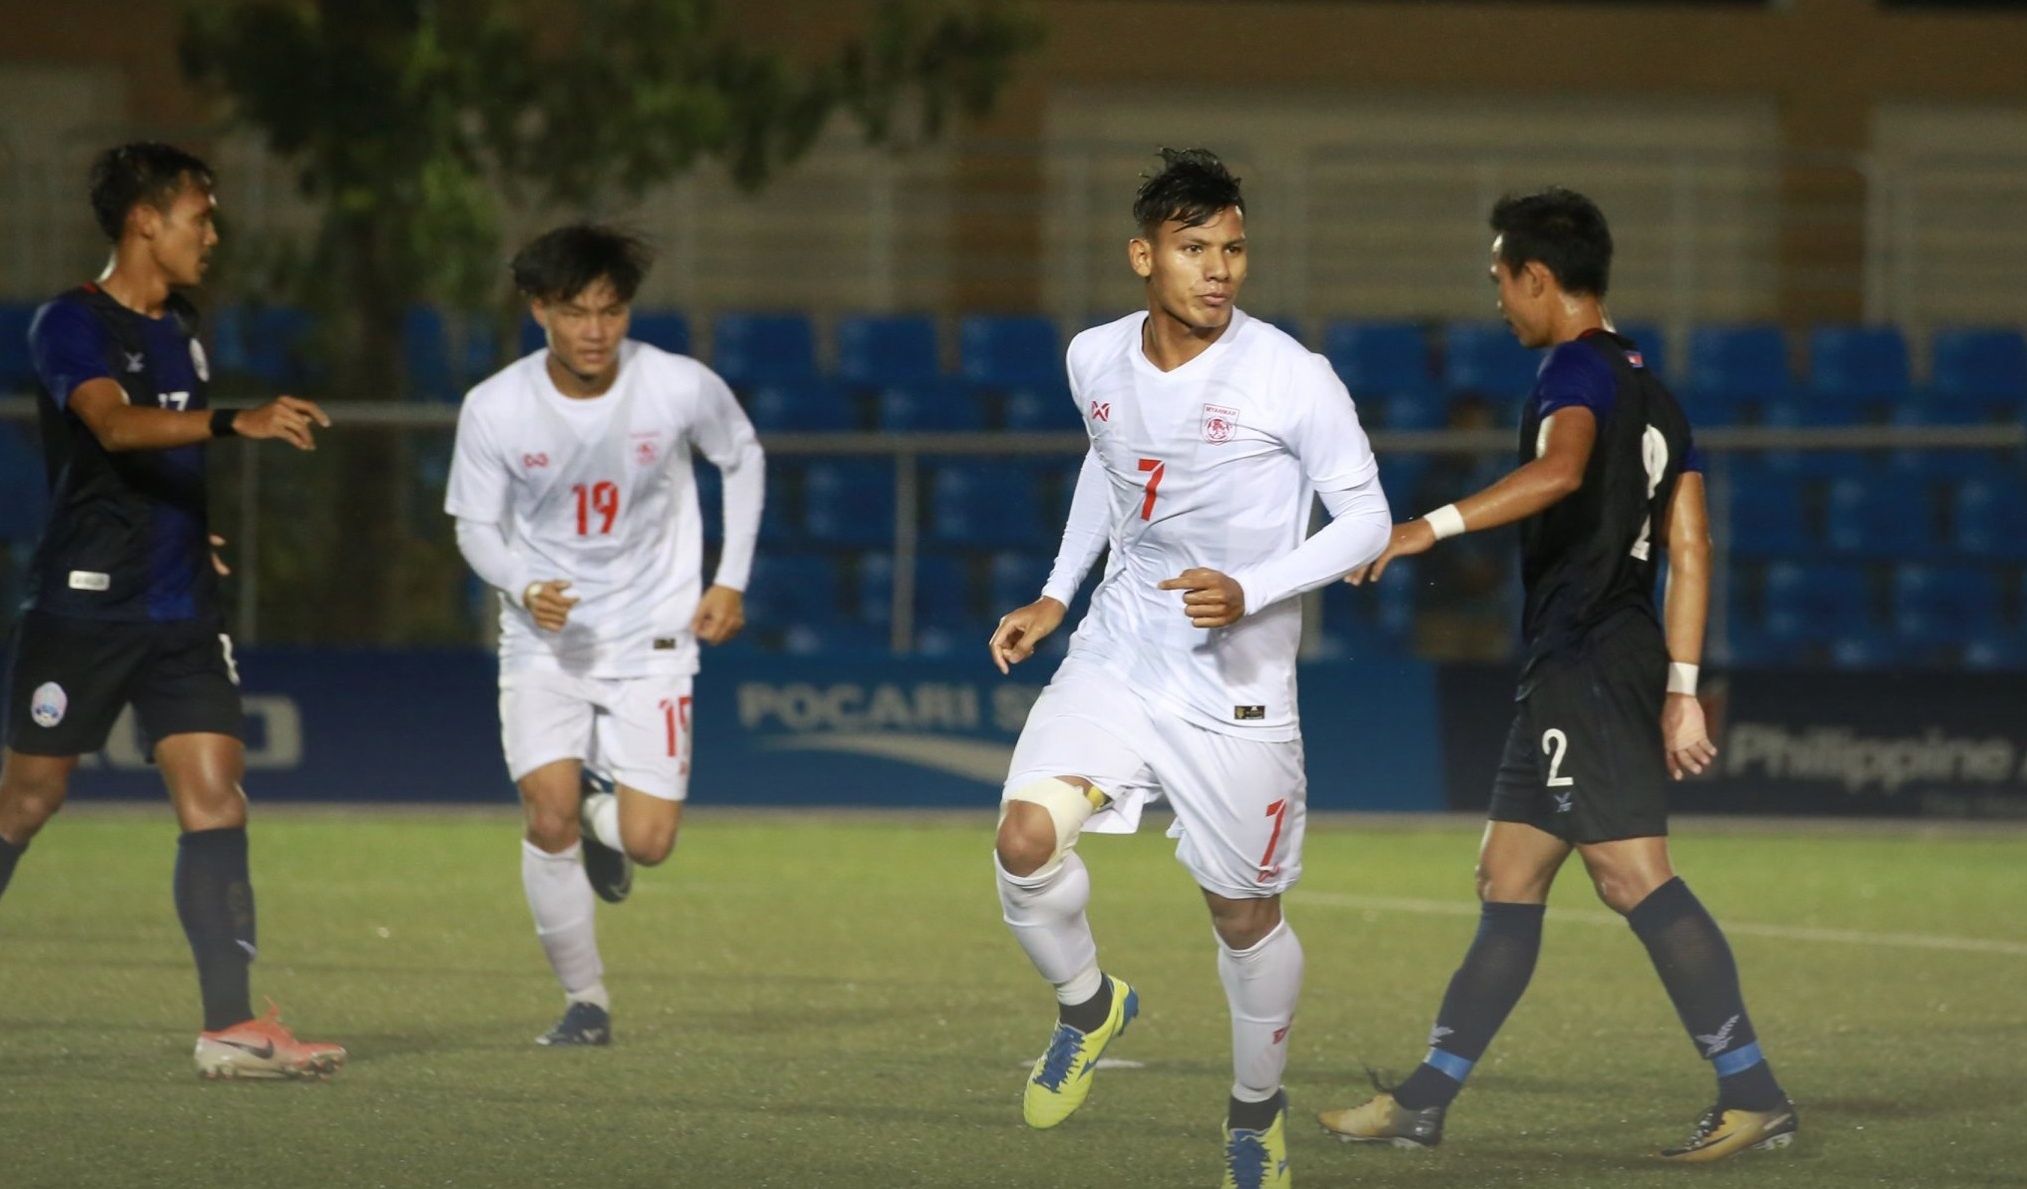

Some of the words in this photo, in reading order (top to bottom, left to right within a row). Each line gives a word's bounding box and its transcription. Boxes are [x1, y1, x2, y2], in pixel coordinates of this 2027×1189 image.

[572, 481, 619, 536] 19
[1138, 459, 1164, 521] 7
[738, 683, 978, 729] POCARI
[993, 685, 1037, 732] S
[1542, 728, 1574, 787] 2
[1728, 722, 2014, 794] Philippine
[1260, 799, 1286, 867] 7
